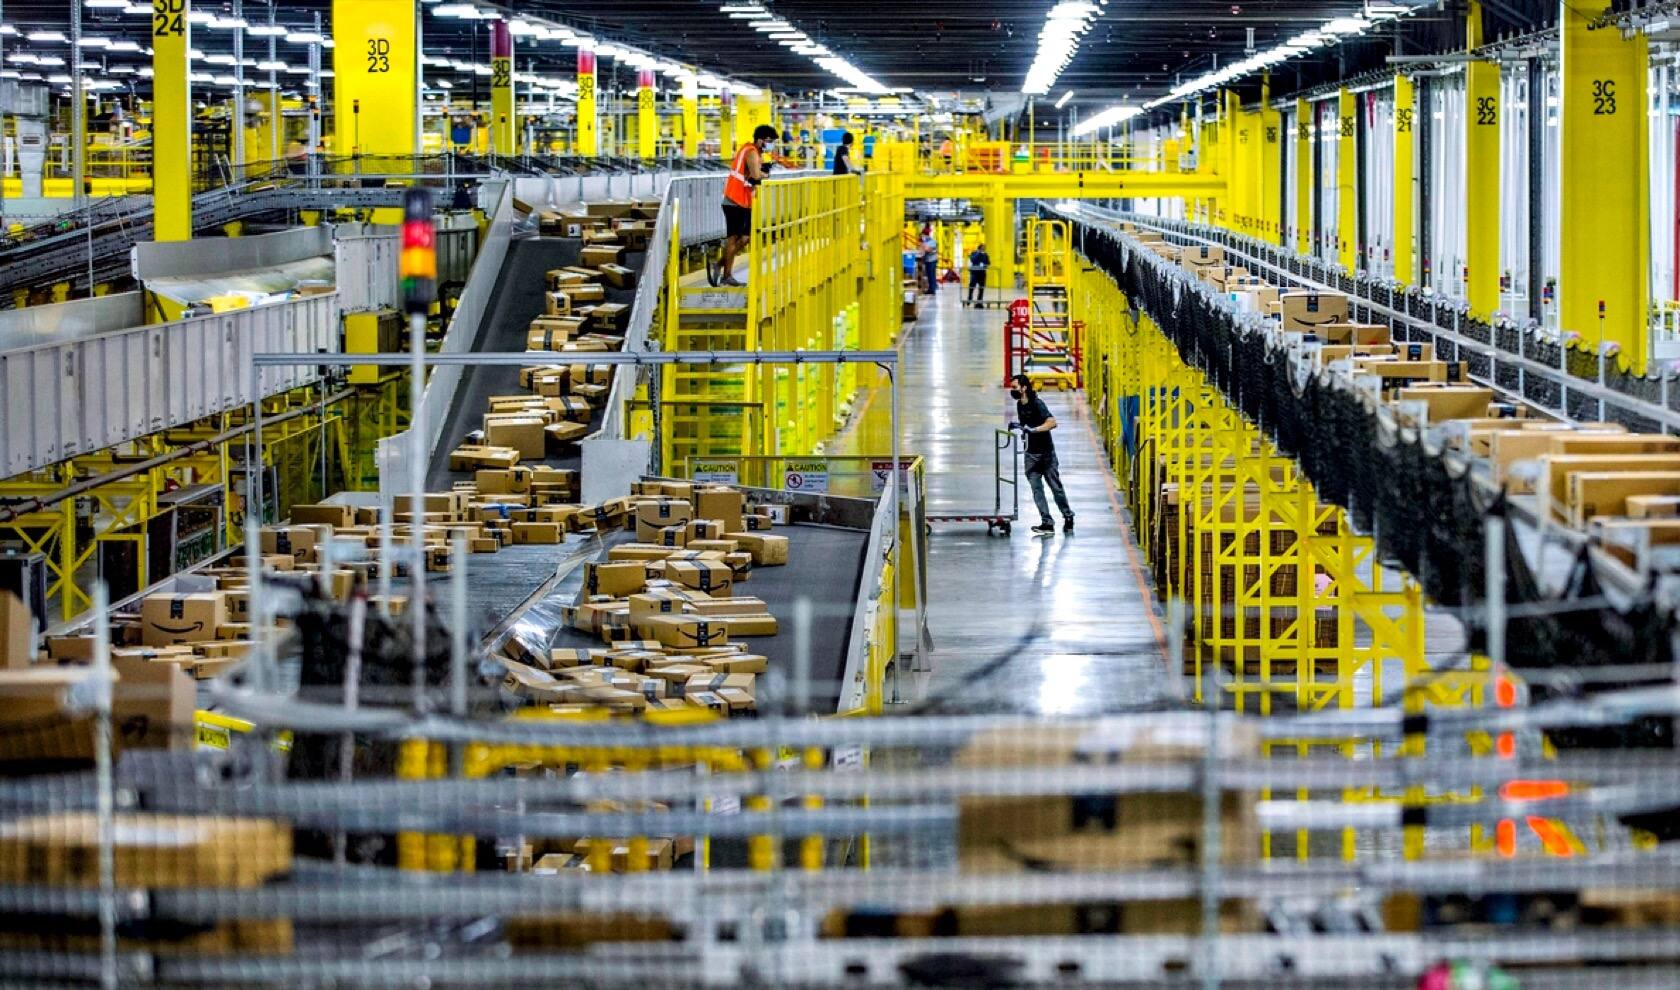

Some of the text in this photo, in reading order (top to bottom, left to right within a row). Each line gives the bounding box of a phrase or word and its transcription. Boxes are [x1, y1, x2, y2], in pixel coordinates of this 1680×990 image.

[155, 0, 185, 13] 3D
[155, 14, 185, 36] 24
[367, 38, 390, 56] 3D
[367, 56, 390, 72] 23
[492, 60, 510, 73] 3D
[493, 74, 511, 87] 22
[580, 76, 594, 88] 3D
[580, 89, 593, 99] 21
[1592, 80, 1615, 97] 3C
[1477, 97, 1496, 111] 3C
[1594, 97, 1616, 114] 23
[1397, 108, 1412, 120] 3C
[1478, 111, 1496, 125] 22
[1341, 126, 1353, 136] 20
[1397, 120, 1411, 132] 21
[703, 464, 736, 472] CAUTION
[795, 463, 827, 472] CAUTION
